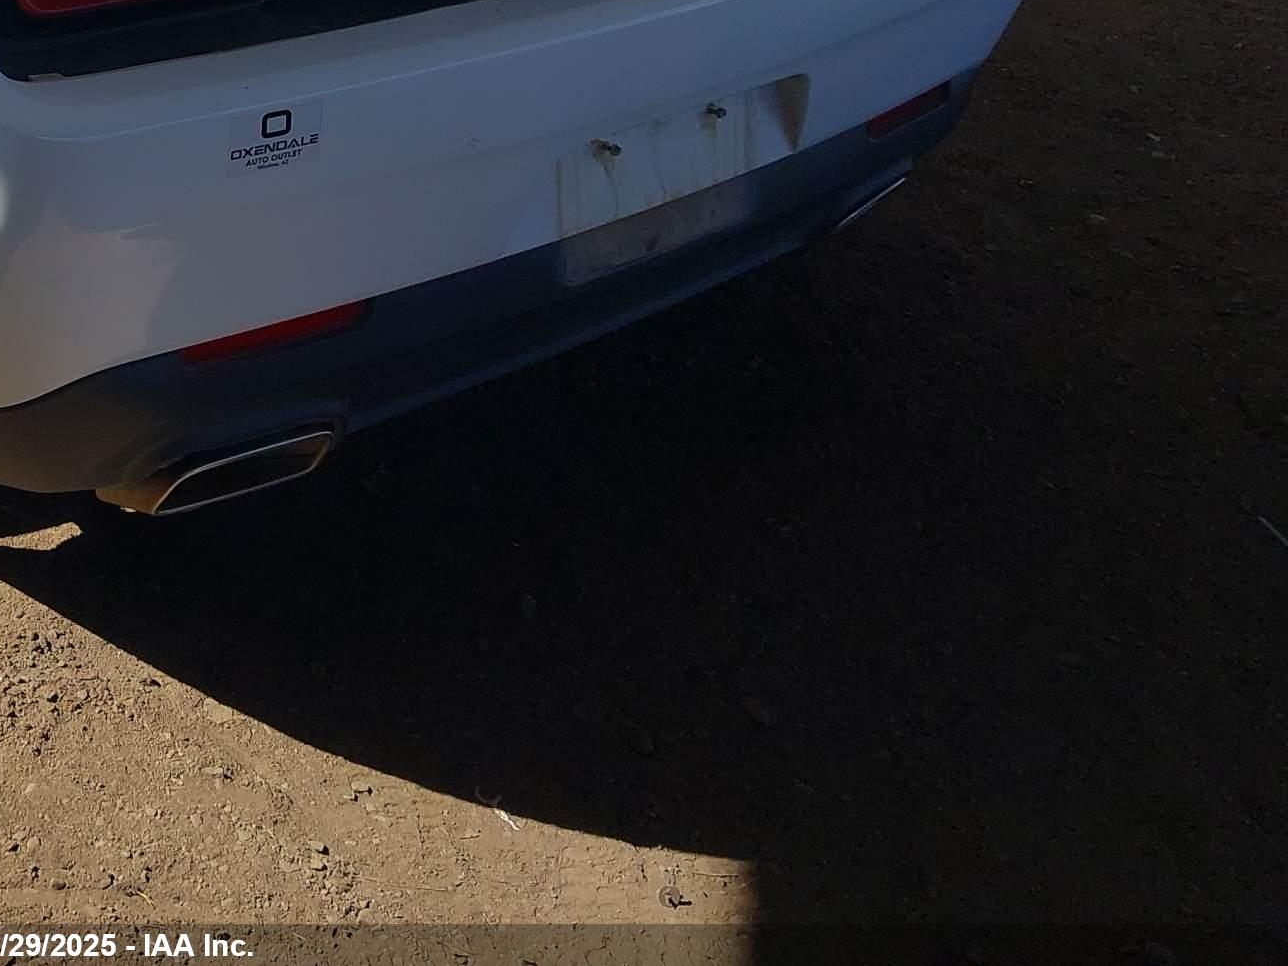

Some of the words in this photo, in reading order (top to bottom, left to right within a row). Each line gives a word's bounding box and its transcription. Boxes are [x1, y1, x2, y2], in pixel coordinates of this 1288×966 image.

[230, 133, 320, 161] OXENDALE
[245, 156, 269, 167] AUTO
[271, 149, 303, 162] OUTLET
